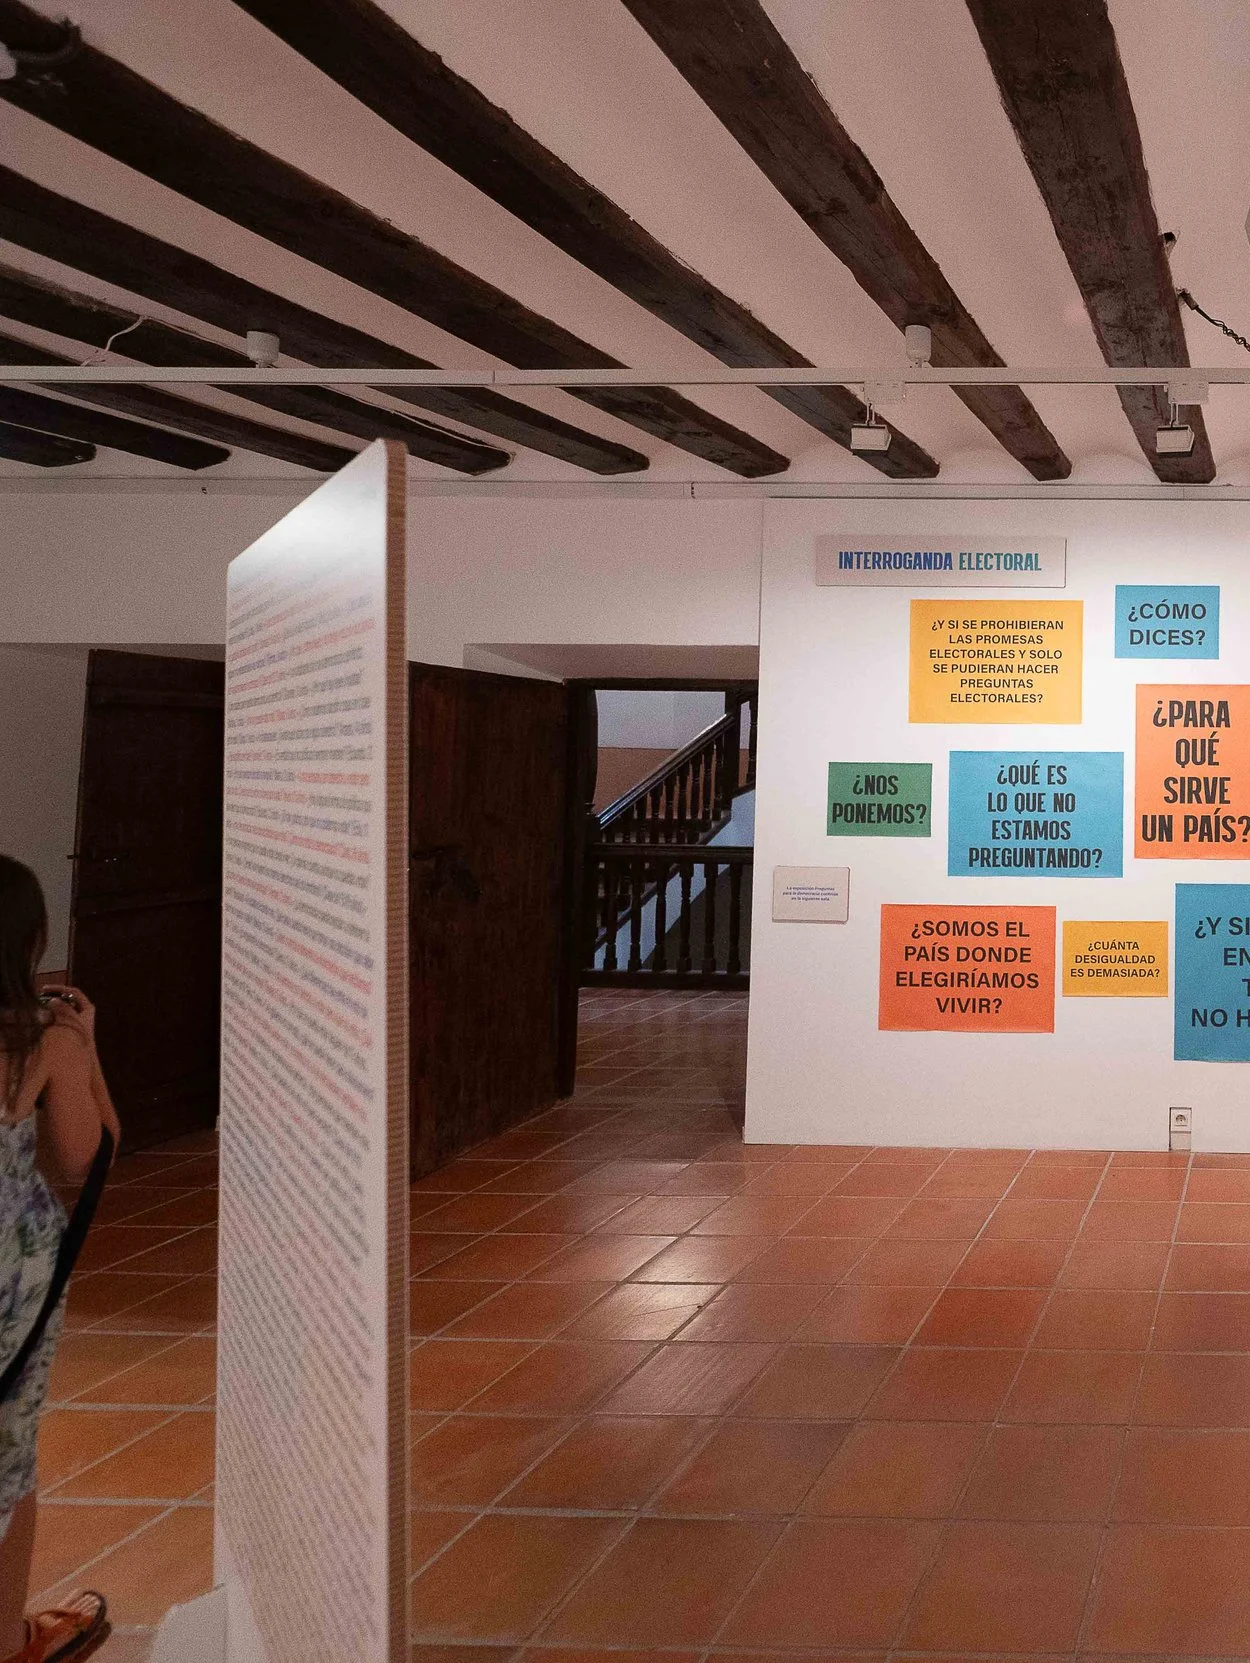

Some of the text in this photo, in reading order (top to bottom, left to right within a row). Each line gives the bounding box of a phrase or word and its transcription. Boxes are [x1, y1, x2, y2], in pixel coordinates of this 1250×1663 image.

[839, 552, 1041, 570] INTERROGANDA ELECTORAL
[1128, 599, 1206, 622] ¿CÓMO
[932, 620, 1063, 631] ¿Y SI SE PROHIBIERAN
[950, 635, 1043, 644] LAS PROMESAS
[1130, 630, 1205, 645] DICES?
[930, 649, 1062, 659] ELECTORALES Y SOLO
[933, 664, 1058, 674] SE PUDIERAN HACER
[960, 679, 1033, 688] PREGUNTAS
[950, 694, 1043, 703] ELECTORALES?
[1153, 701, 1230, 728] ¿PARA
[1176, 731, 1219, 768] QUÉ
[997, 760, 1067, 786] ¿QUÉ ES
[853, 775, 898, 795] ¿NOS
[1164, 777, 1230, 804] SIRVE
[988, 792, 1075, 814] LO QUE NO
[832, 803, 926, 824] PONEMOS?
[992, 820, 1070, 840] ESTAMOS
[1142, 815, 1172, 842] UN
[969, 848, 1102, 868] PREGUNTANDO?
[912, 920, 1030, 939] ¿SOMOS EL
[1195, 917, 1221, 938] ¿Y
[1229, 917, 1250, 935] SI
[905, 942, 1031, 962] PAÍS DONDE
[1088, 940, 1139, 952] ¿CUÁNTA
[1075, 955, 1155, 964] DESIGUALDAD
[896, 968, 1038, 988] ELEGIRÍAMOS
[1071, 968, 1160, 977] ES DEMASIADA?
[936, 998, 1002, 1013] VIVIR?
[1192, 1009, 1228, 1027] NO
